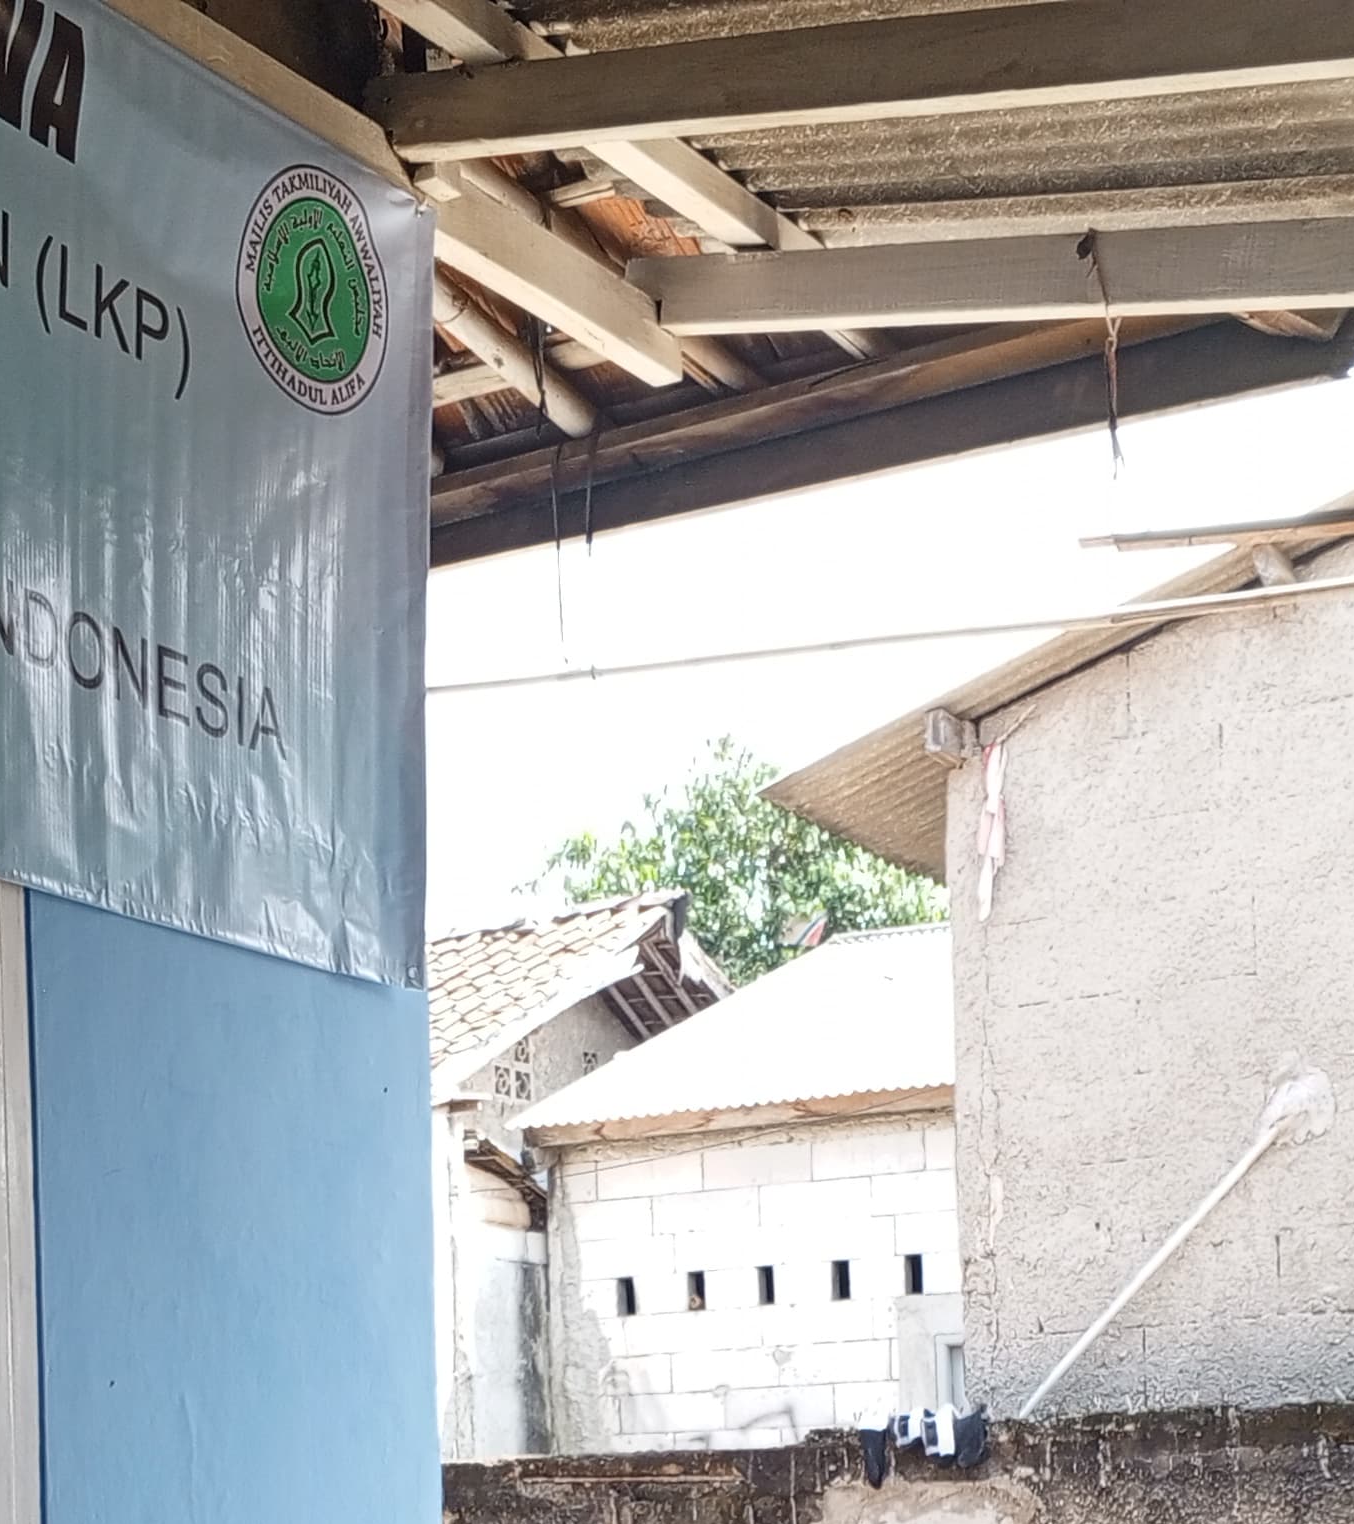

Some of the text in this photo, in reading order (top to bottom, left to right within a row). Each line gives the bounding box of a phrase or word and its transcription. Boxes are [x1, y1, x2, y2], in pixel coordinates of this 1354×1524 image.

[35, 234, 190, 401] (LKP)
[245, 172, 384, 340] MAJLIS TAKMILIYAH AWWALIYAH
[330, 372, 366, 406] ALIFA
